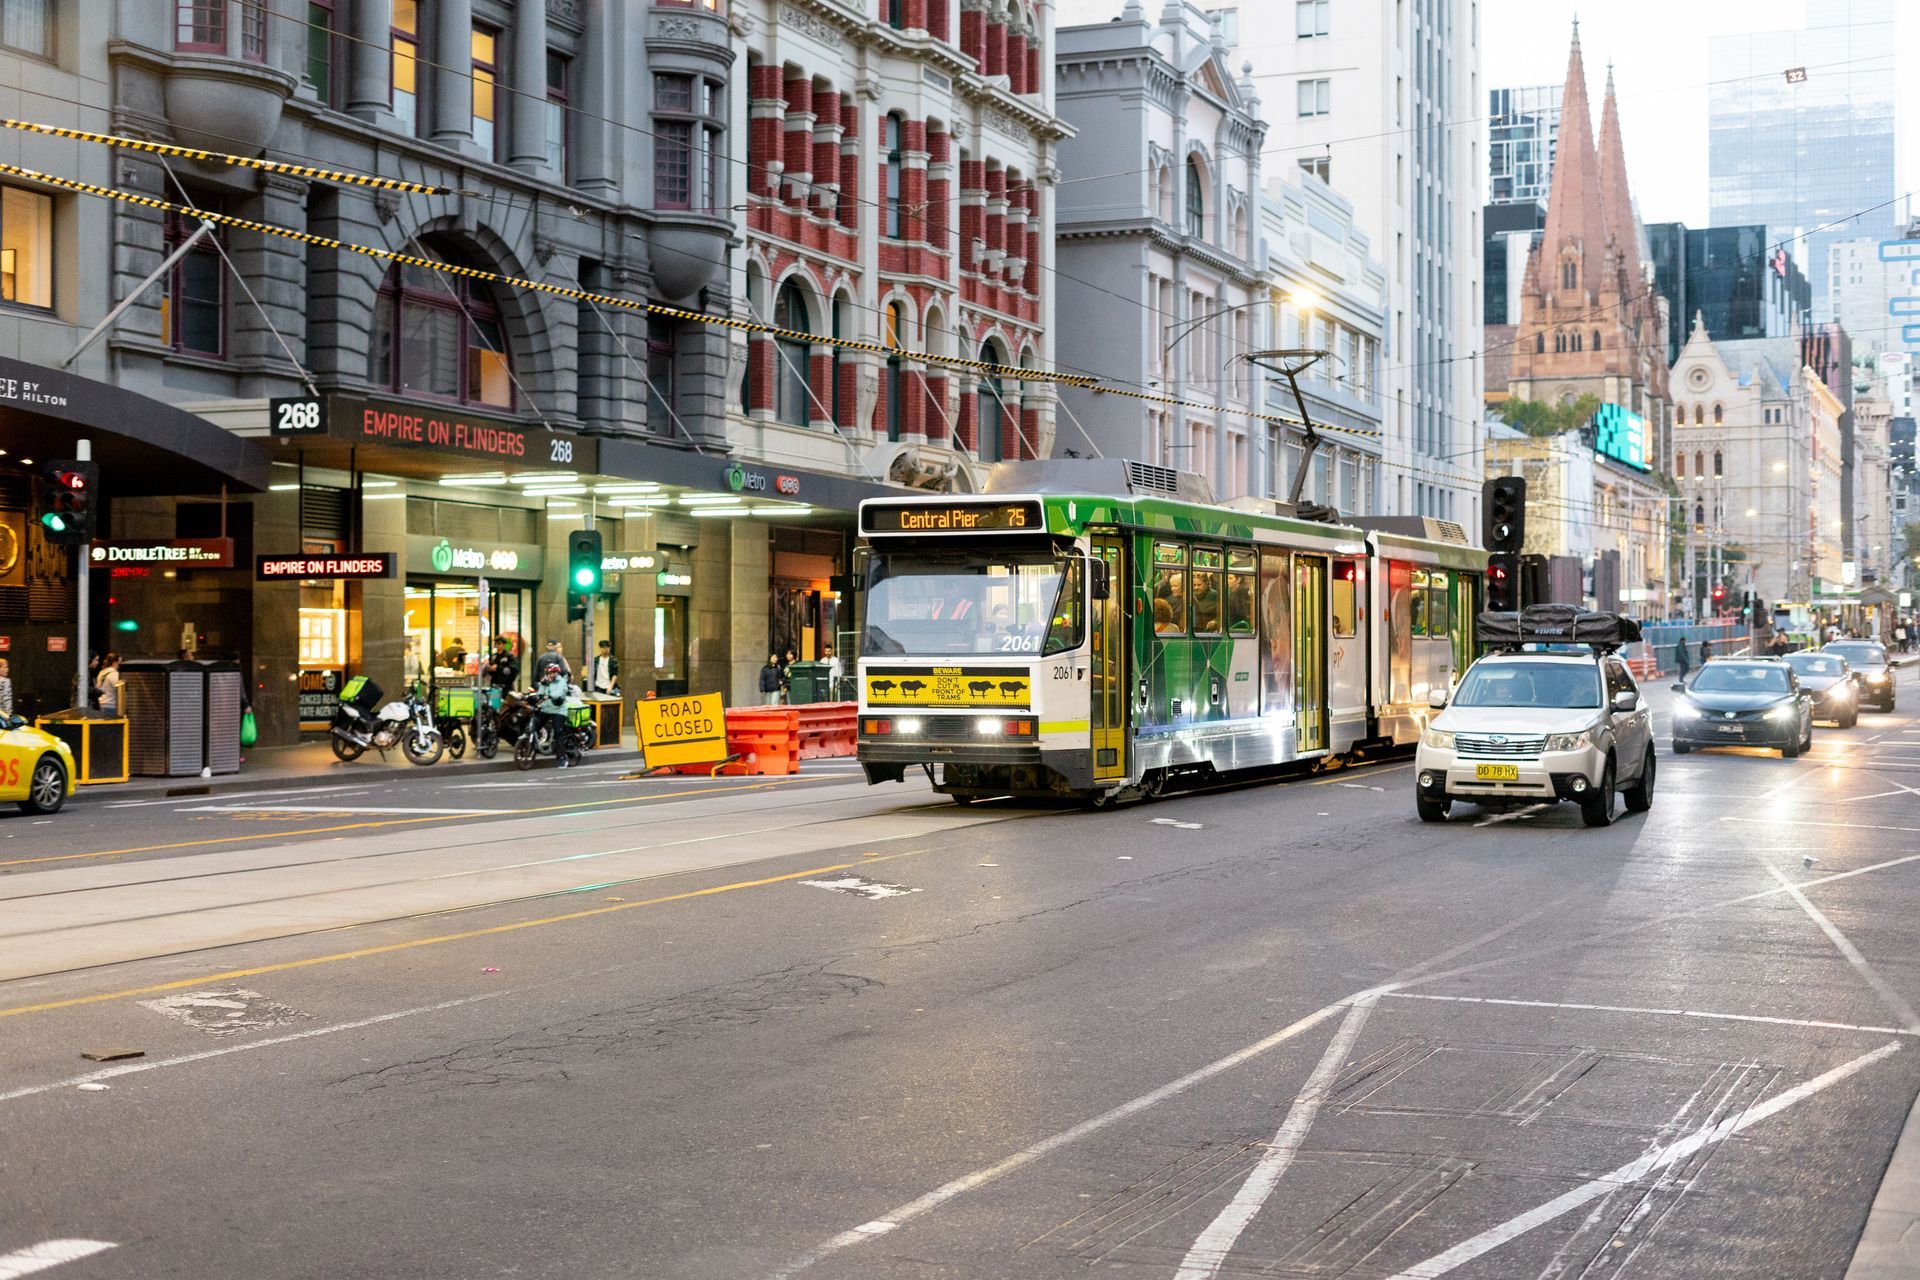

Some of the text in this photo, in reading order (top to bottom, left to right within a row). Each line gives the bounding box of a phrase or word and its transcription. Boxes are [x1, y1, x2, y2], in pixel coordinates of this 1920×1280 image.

[1788, 70, 1804, 82] 32
[23, 381, 40, 391] BY
[23, 392, 67, 406] HILTON
[278, 402, 320, 429] 268
[363, 409, 525, 457] EMPIRE ON FLINDERS
[550, 438, 573, 463] 268
[901, 508, 1025, 528] Central Pier 75
[263, 559, 383, 575] EMPIRE ON FLINDERS
[1001, 635, 1040, 651] 2061
[933, 667, 962, 675] BEWARE
[1053, 666, 1073, 680] 2061
[660, 700, 702, 718] ROAD
[654, 719, 713, 738] CLOSED
[1478, 766, 1516, 777] DD 78 HX
